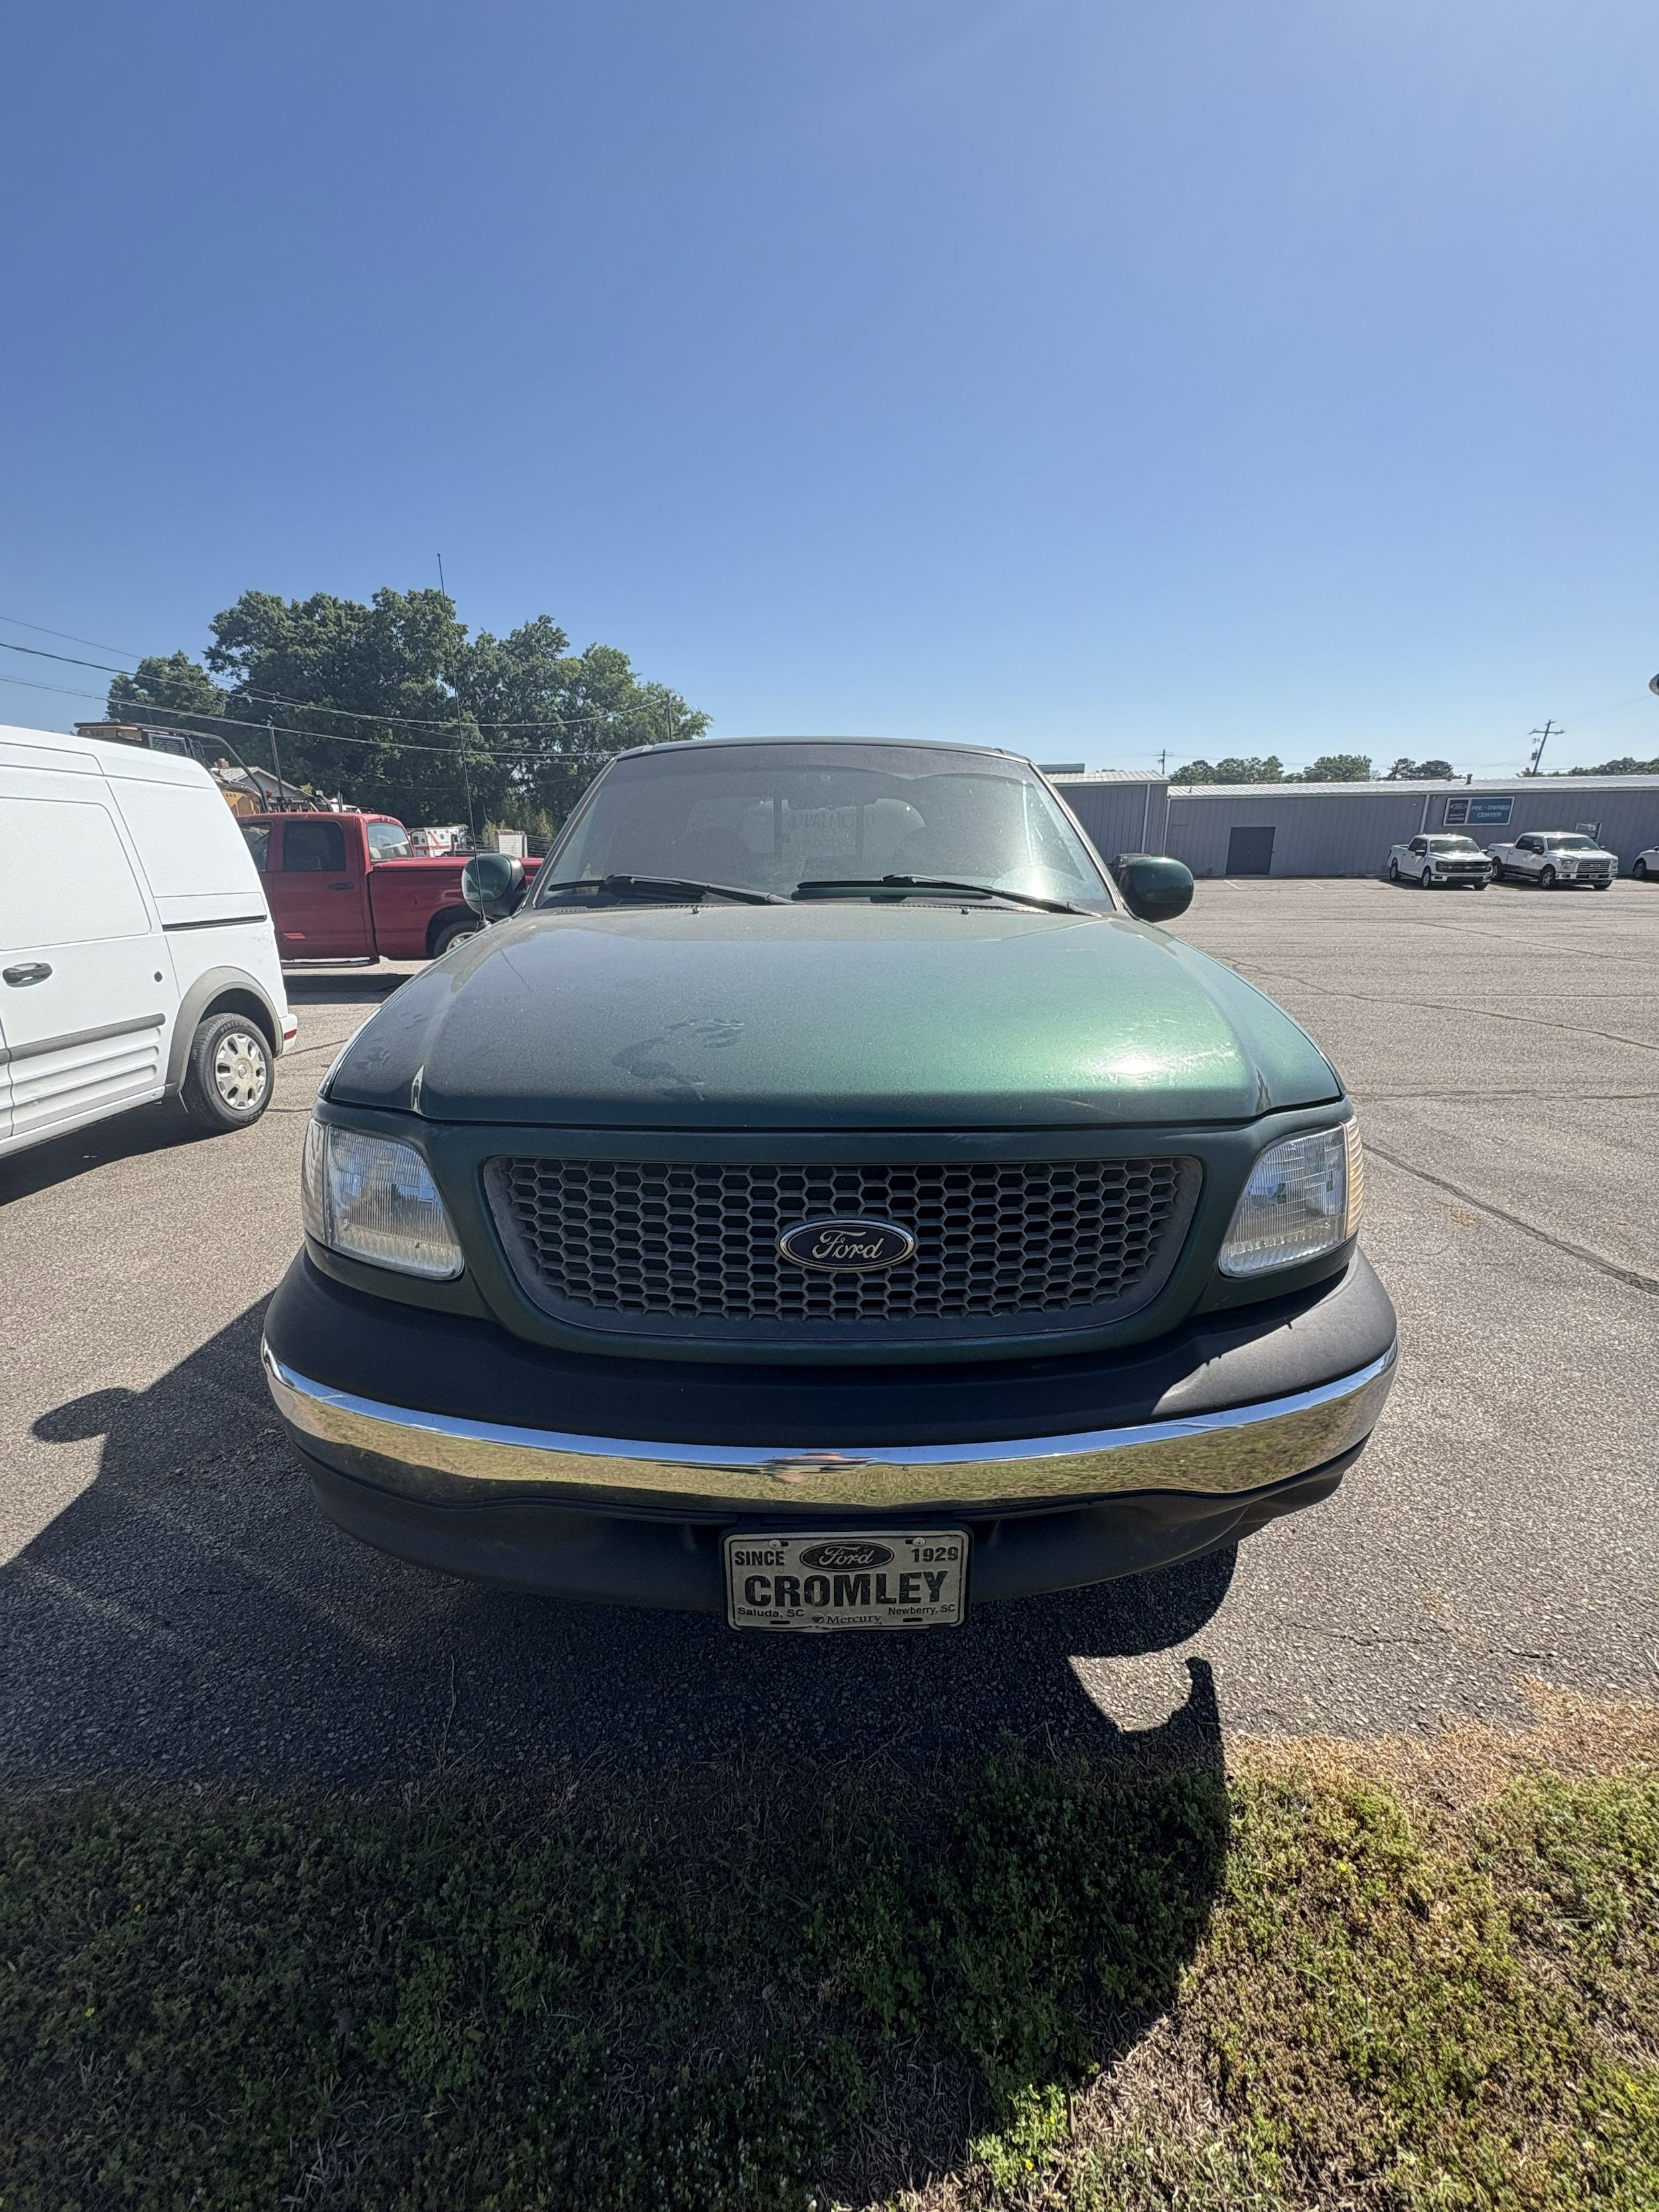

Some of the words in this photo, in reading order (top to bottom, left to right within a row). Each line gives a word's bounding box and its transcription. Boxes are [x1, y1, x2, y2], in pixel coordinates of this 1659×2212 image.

[804, 812, 875, 828] PALMETO
[812, 1229, 885, 1259] Ford
[734, 1550, 785, 1566] SINCE
[818, 1544, 874, 1566] Ford
[911, 1546, 959, 1563] 1929
[744, 1570, 949, 1607] CROMLEY
[737, 1607, 783, 1619] Saluda,
[786, 1609, 806, 1617] SC
[888, 1606, 938, 1615] Newberry,
[940, 1603, 956, 1613] SC
[827, 1615, 883, 1625] Mercury
